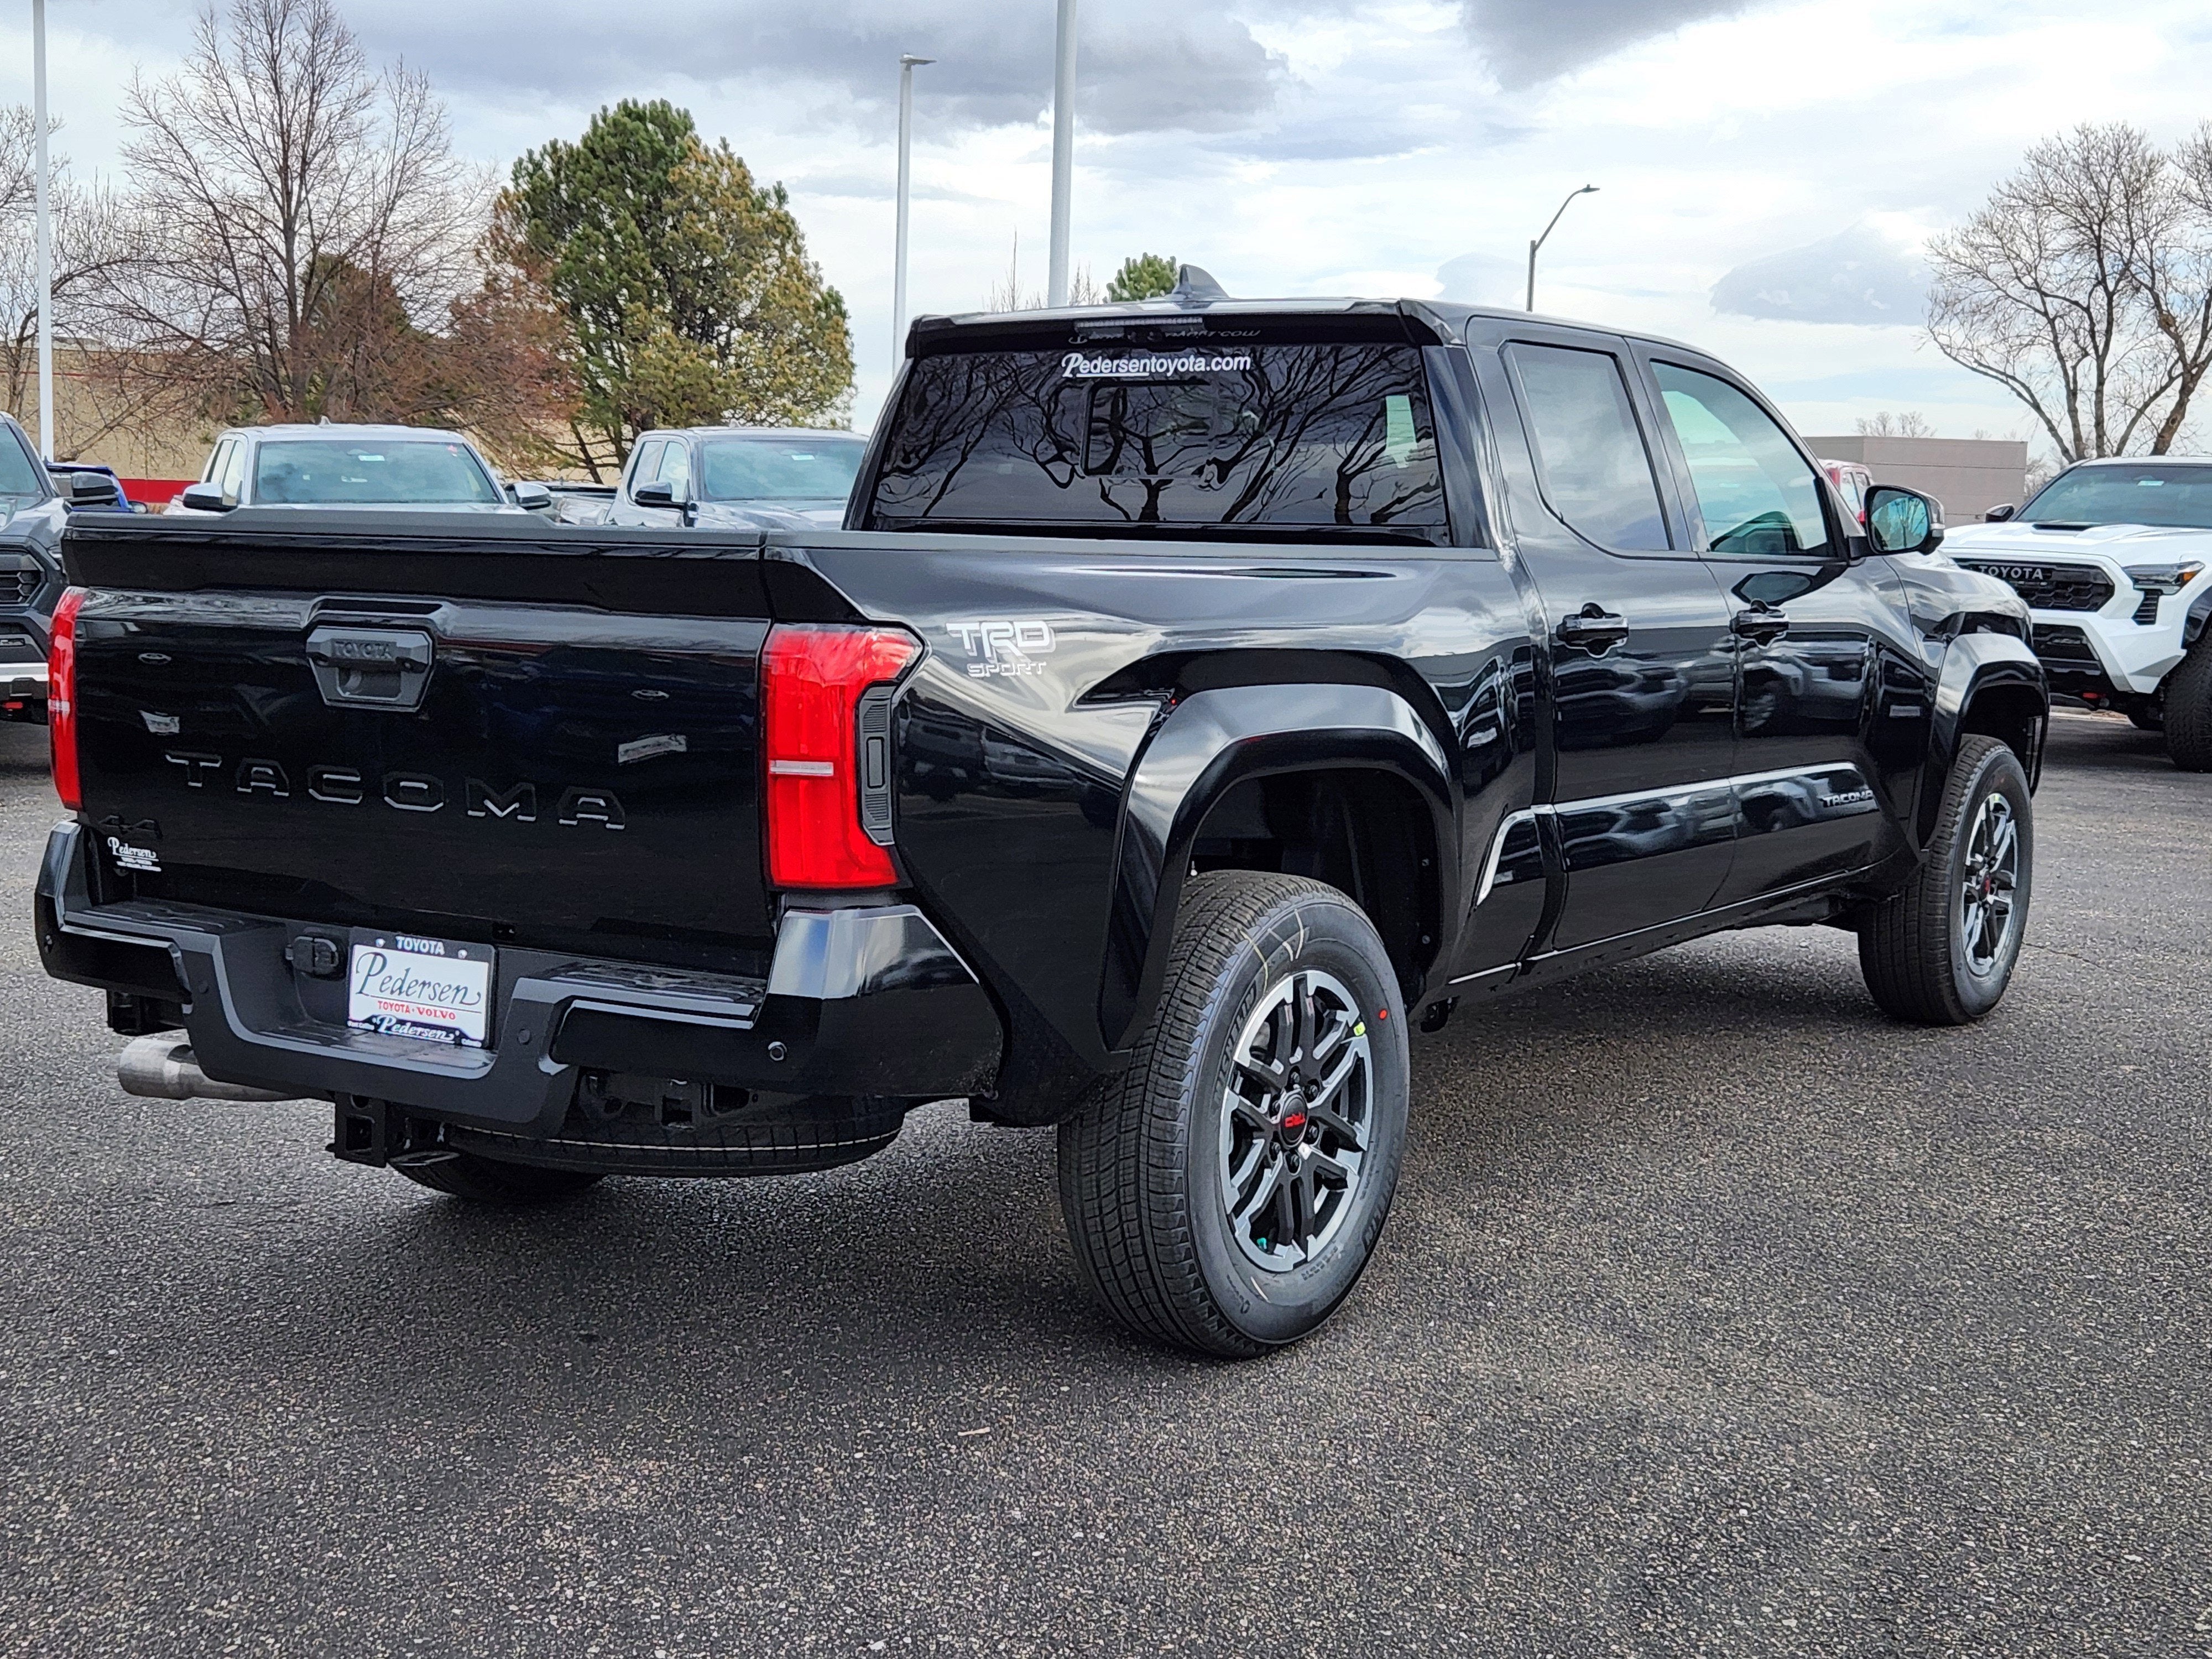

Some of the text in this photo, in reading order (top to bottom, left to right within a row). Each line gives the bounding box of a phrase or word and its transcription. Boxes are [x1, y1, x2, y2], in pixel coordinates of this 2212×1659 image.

[1061, 353, 1251, 378] Pedersentoyota.com
[1978, 565, 2044, 580] TOYOTA
[333, 639, 394, 660] TOYOTA
[945, 620, 1051, 659] TRD
[967, 661, 1047, 677] SPORT
[164, 750, 625, 830] TACOMA
[107, 836, 157, 859] Pedersen
[395, 935, 445, 956] TOYOTA
[355, 951, 482, 1006] Pedersen
[377, 1000, 456, 1021] TOYOTA VOLVO
[375, 1014, 455, 1041] Pedersen
